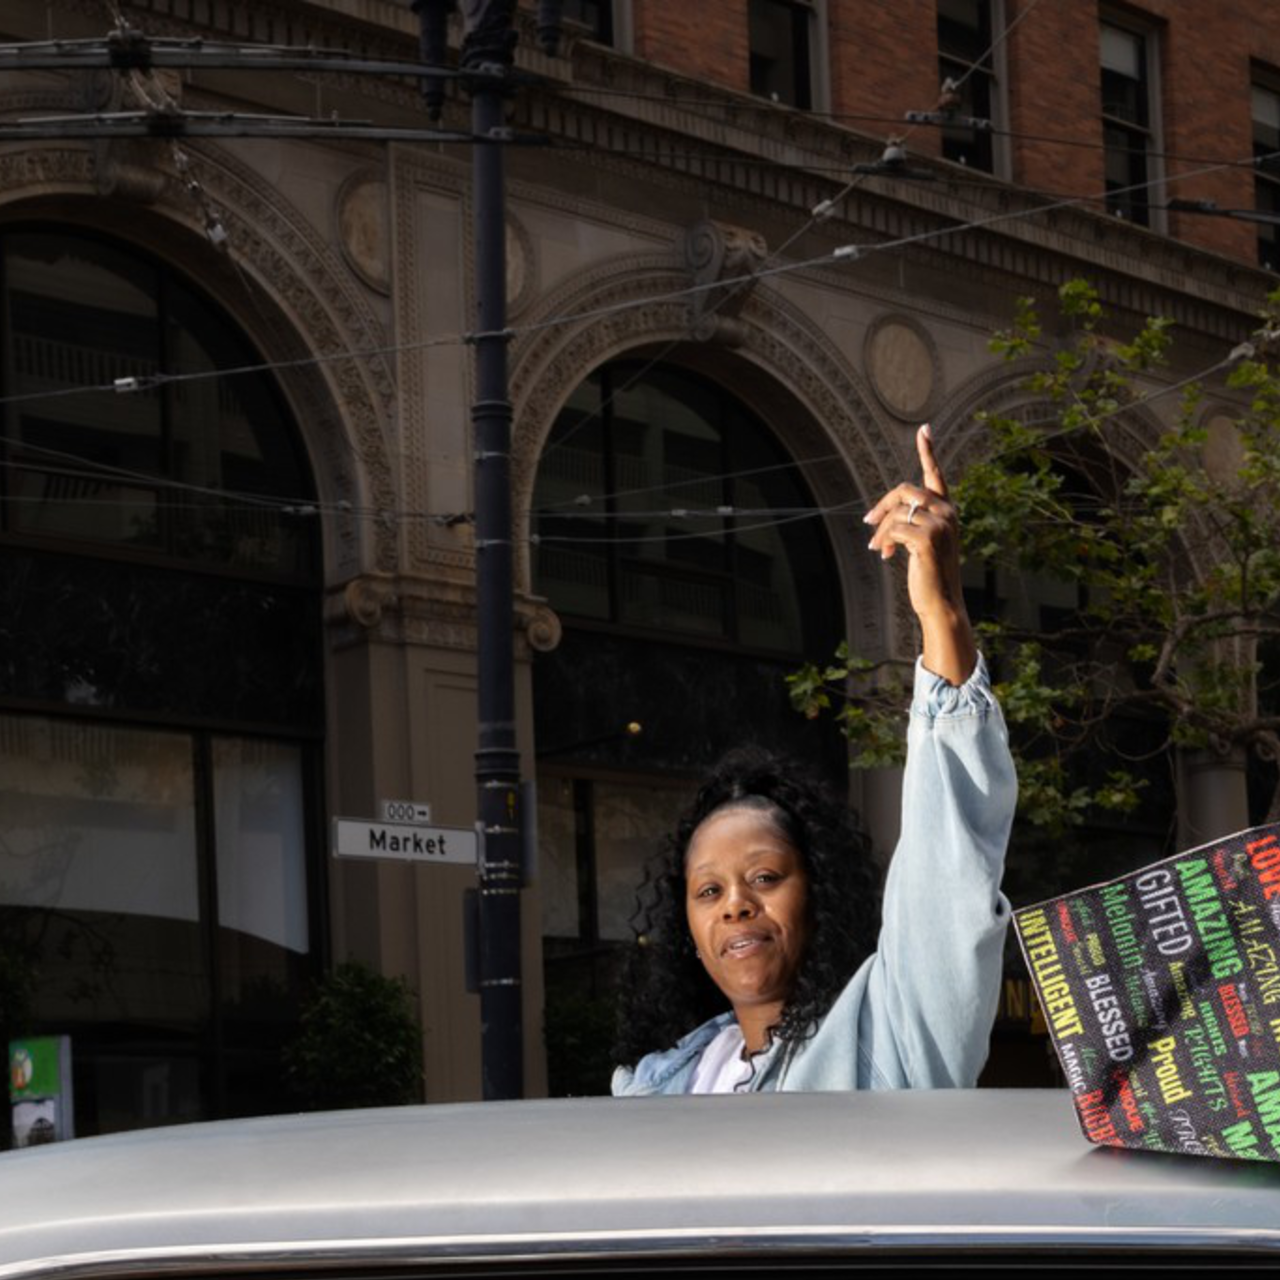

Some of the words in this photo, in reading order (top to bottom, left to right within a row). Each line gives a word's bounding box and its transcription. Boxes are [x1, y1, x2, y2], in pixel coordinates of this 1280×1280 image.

[369, 829, 446, 855] Market
[387, 803, 415, 820] 000
[1098, 882, 1144, 969] Melanin
[1133, 869, 1195, 956] GIFTED
[1174, 857, 1245, 982] AMAZING
[1017, 908, 1084, 1039] INTELLIGENT
[1084, 974, 1136, 1061] BLESSED
[1060, 1043, 1086, 1094] MAGIC
[1146, 1036, 1193, 1104] Proud
